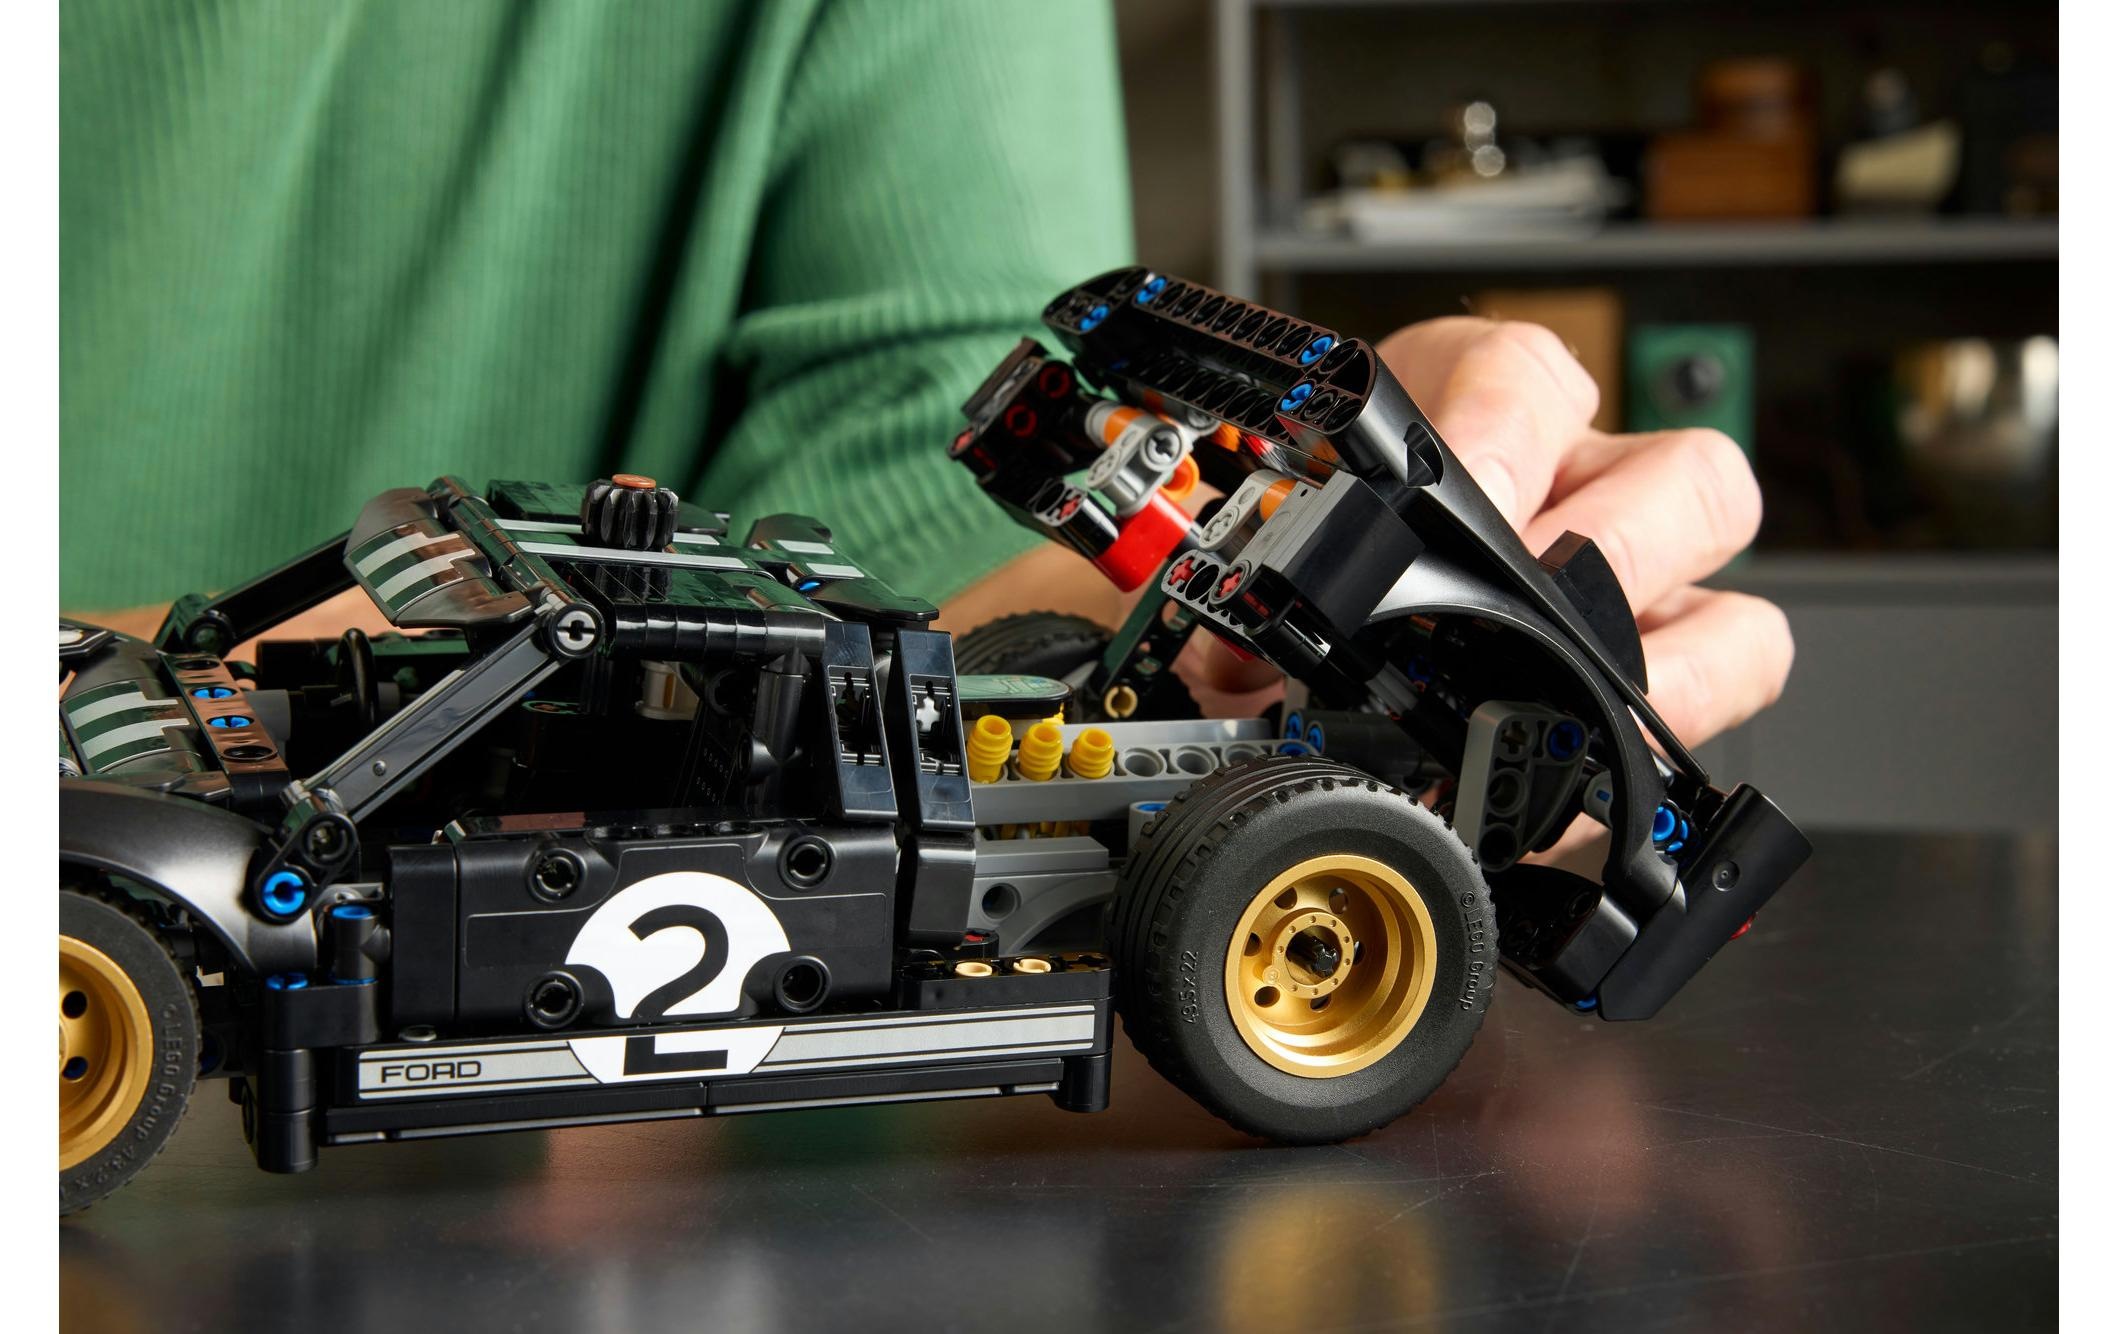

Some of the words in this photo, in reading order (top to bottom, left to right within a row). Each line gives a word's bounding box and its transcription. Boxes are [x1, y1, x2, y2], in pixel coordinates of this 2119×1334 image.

[623, 904, 729, 1076] 2
[1460, 961, 1484, 1010] Group
[380, 1060, 482, 1083] FORD
